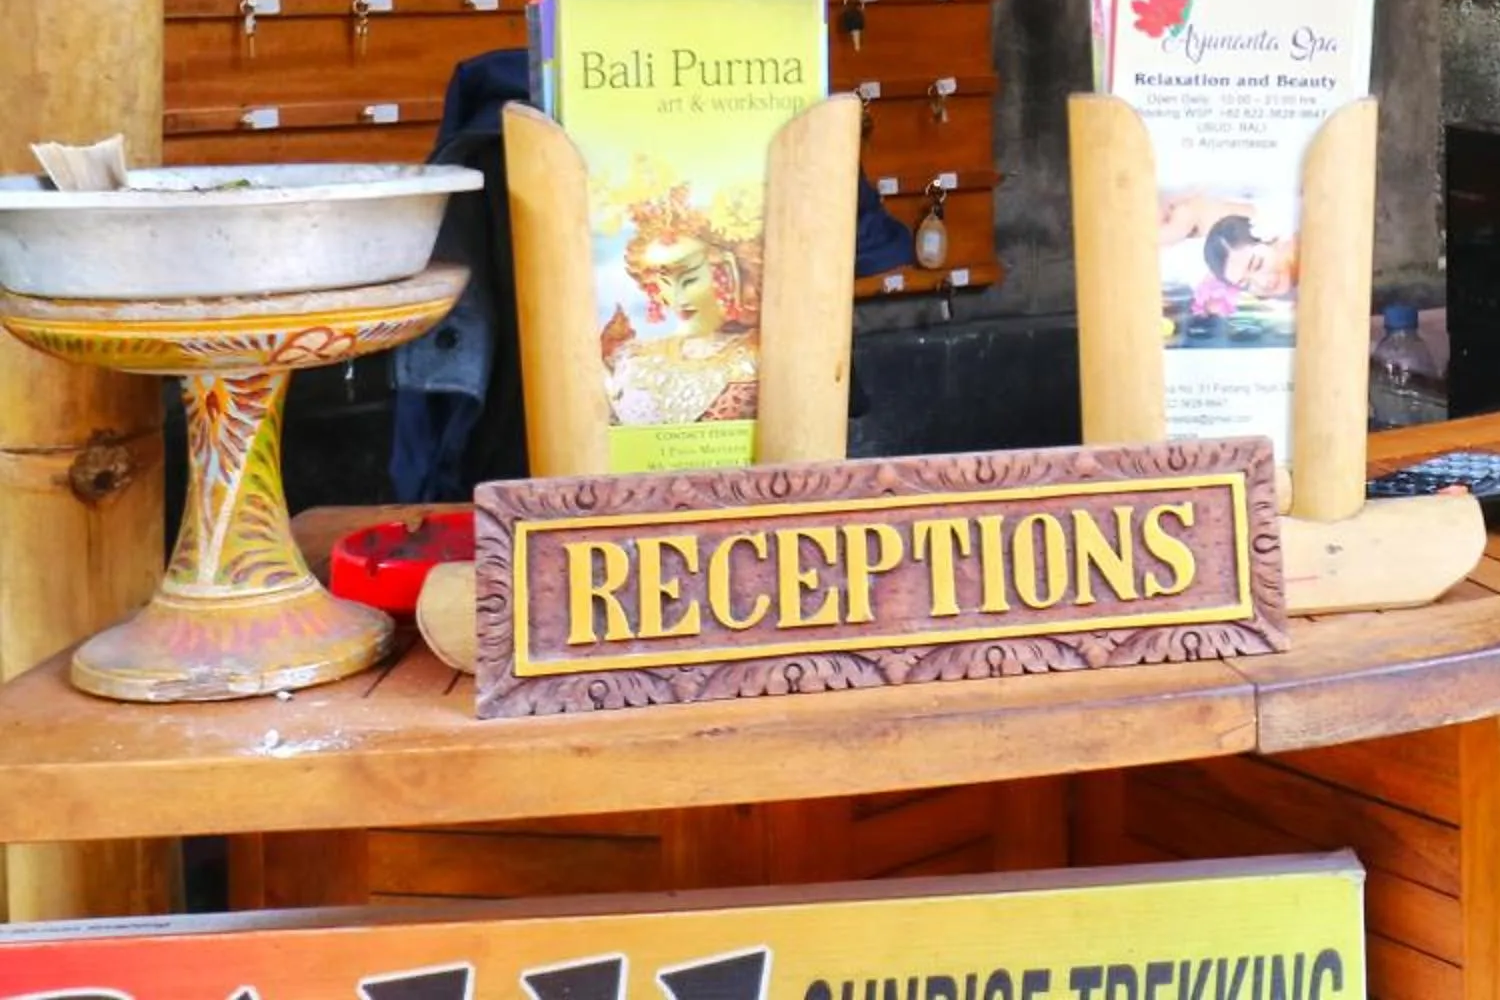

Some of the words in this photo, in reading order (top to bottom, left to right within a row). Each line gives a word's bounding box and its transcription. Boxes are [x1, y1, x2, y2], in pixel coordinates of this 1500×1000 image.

[1289, 25, 1338, 62] Spa
[581, 49, 656, 90] Bali
[672, 48, 804, 88] Purma
[1134, 73, 1230, 87] Relaxation
[1236, 73, 1269, 87] and
[1276, 73, 1337, 91] Beauty
[656, 96, 683, 113] art
[690, 95, 705, 113] &
[712, 92, 805, 115] workshop
[562, 499, 1198, 647] RECEPTIONS
